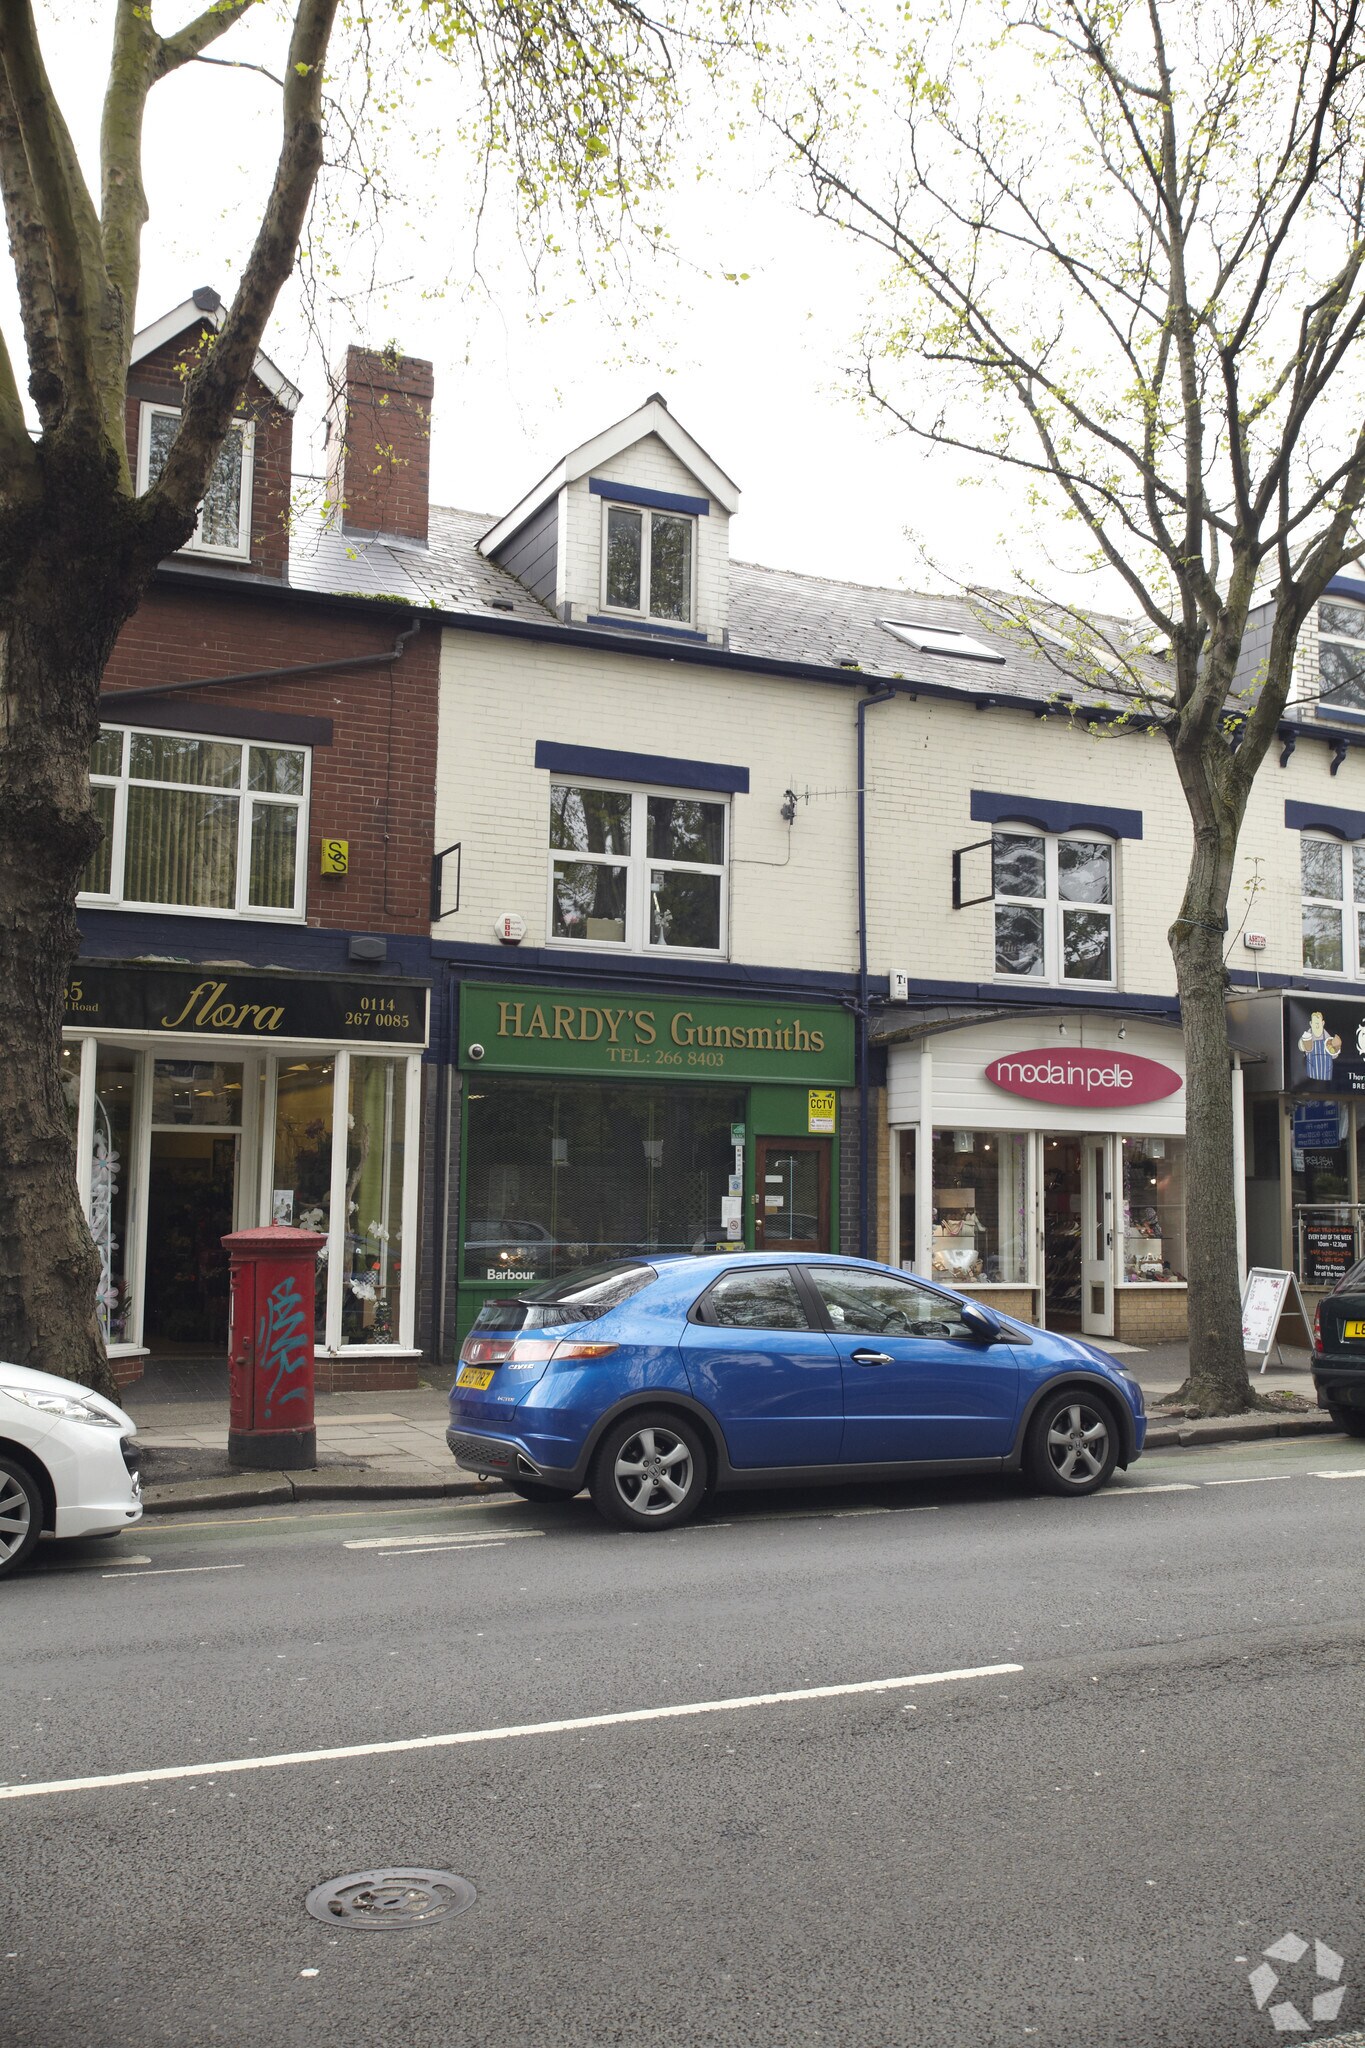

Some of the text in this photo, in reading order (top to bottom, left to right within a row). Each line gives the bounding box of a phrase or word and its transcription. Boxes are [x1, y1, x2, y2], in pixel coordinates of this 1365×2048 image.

[72, 1002, 99, 1012] Road
[161, 981, 285, 1031] flora
[360, 997, 395, 1012] 0114
[344, 1012, 410, 1028] 267 0085
[496, 1002, 825, 1052] HARDY'S Gunsmiths
[606, 1048, 724, 1066] TEL: 266 8403
[810, 1098, 834, 1109] CCTV
[487, 1268, 536, 1280] Barbour
